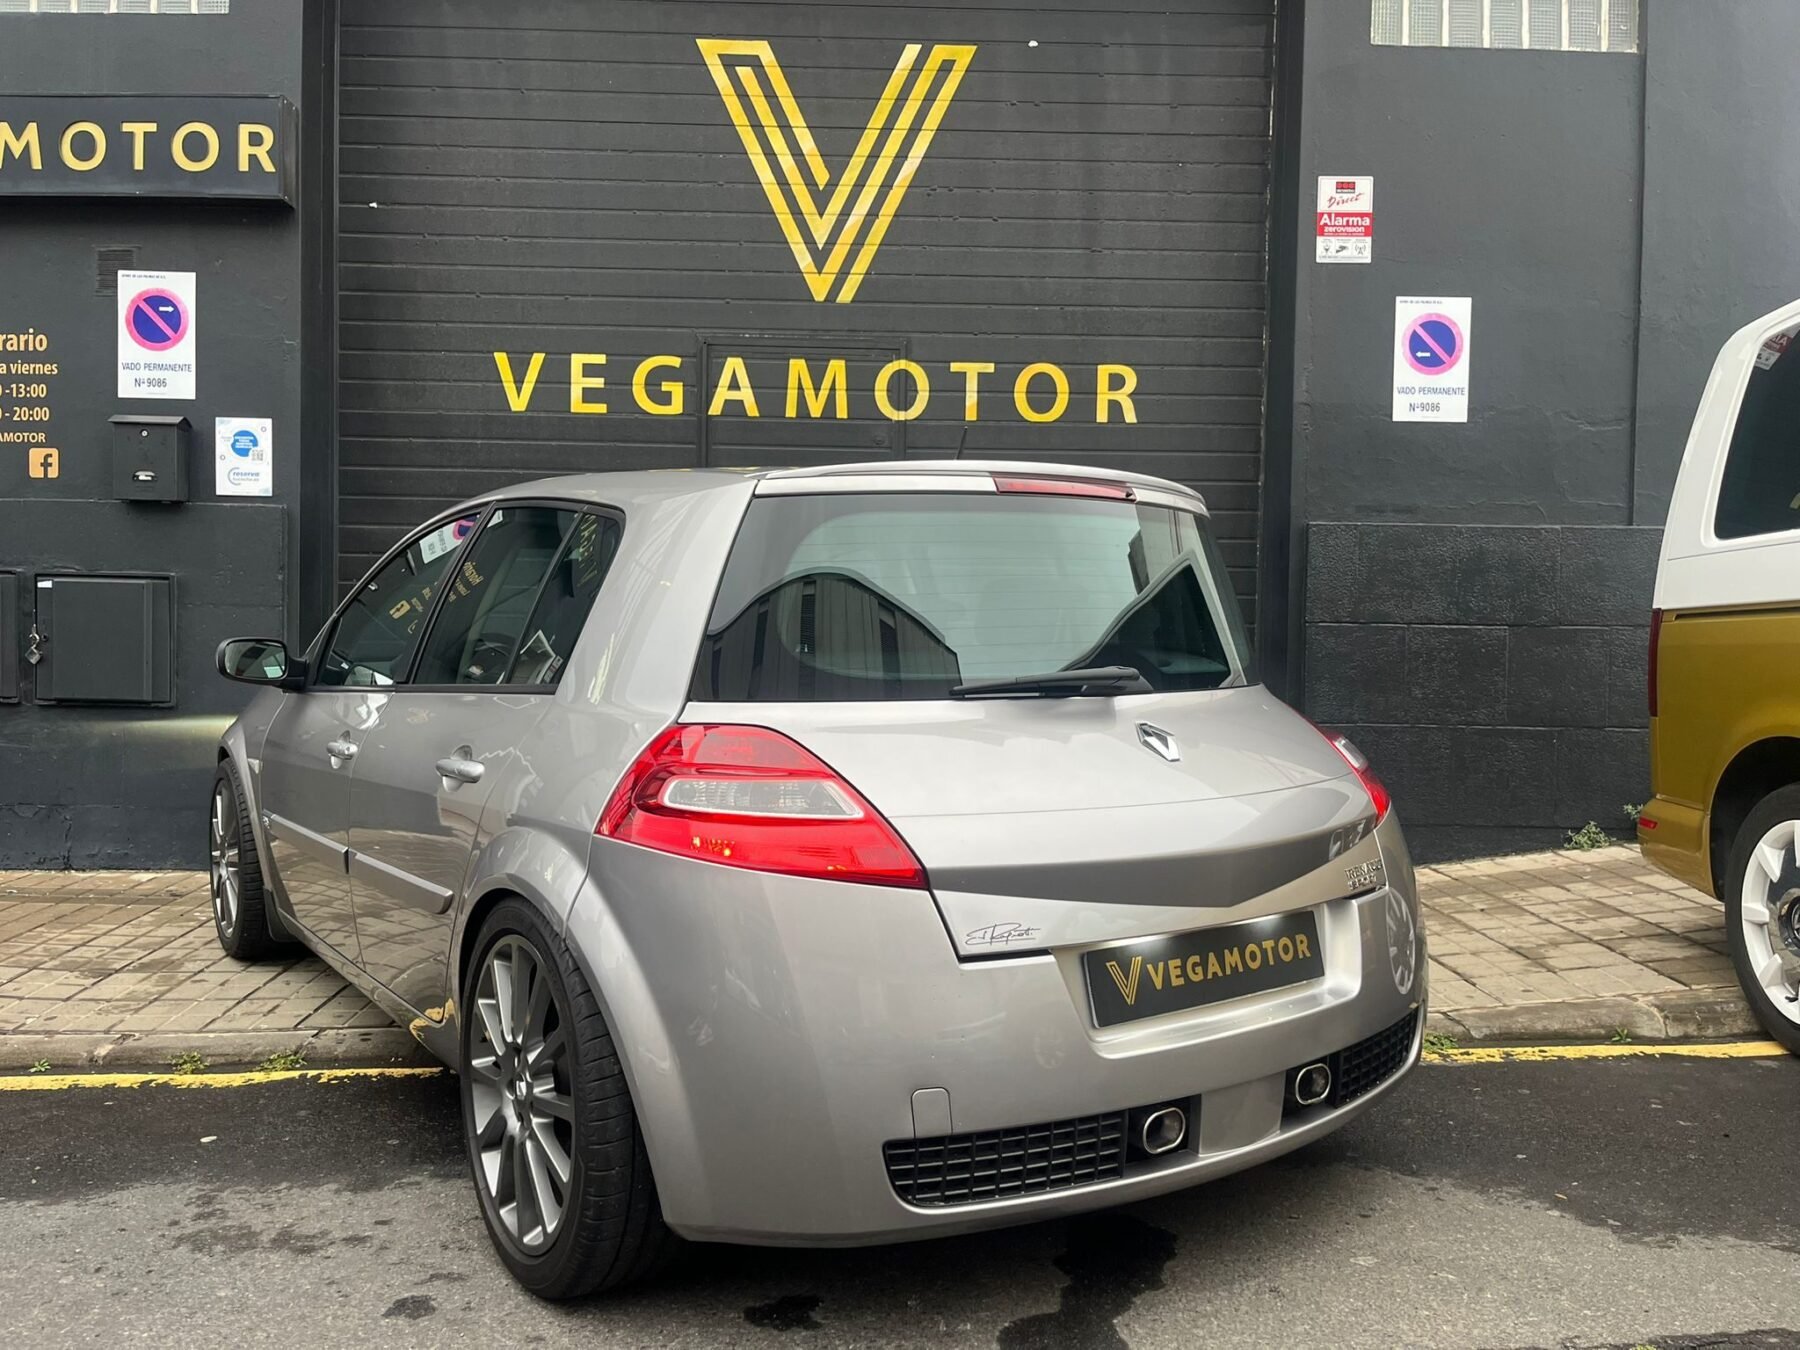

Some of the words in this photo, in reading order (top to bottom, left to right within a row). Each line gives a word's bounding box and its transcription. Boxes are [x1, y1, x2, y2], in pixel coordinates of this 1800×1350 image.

[1320, 213, 1370, 226] Alarma
[10, 360, 58, 375] viernes
[121, 362, 141, 371] VADO
[143, 362, 192, 373] PERMANENTE
[494, 352, 1138, 423] VEGAMOTOR
[1397, 386, 1416, 395] VADO
[1418, 386, 1465, 396] PERMANENTE
[13, 407, 49, 421] 20:00
[1147, 933, 1312, 991] VEGAMOTOR
